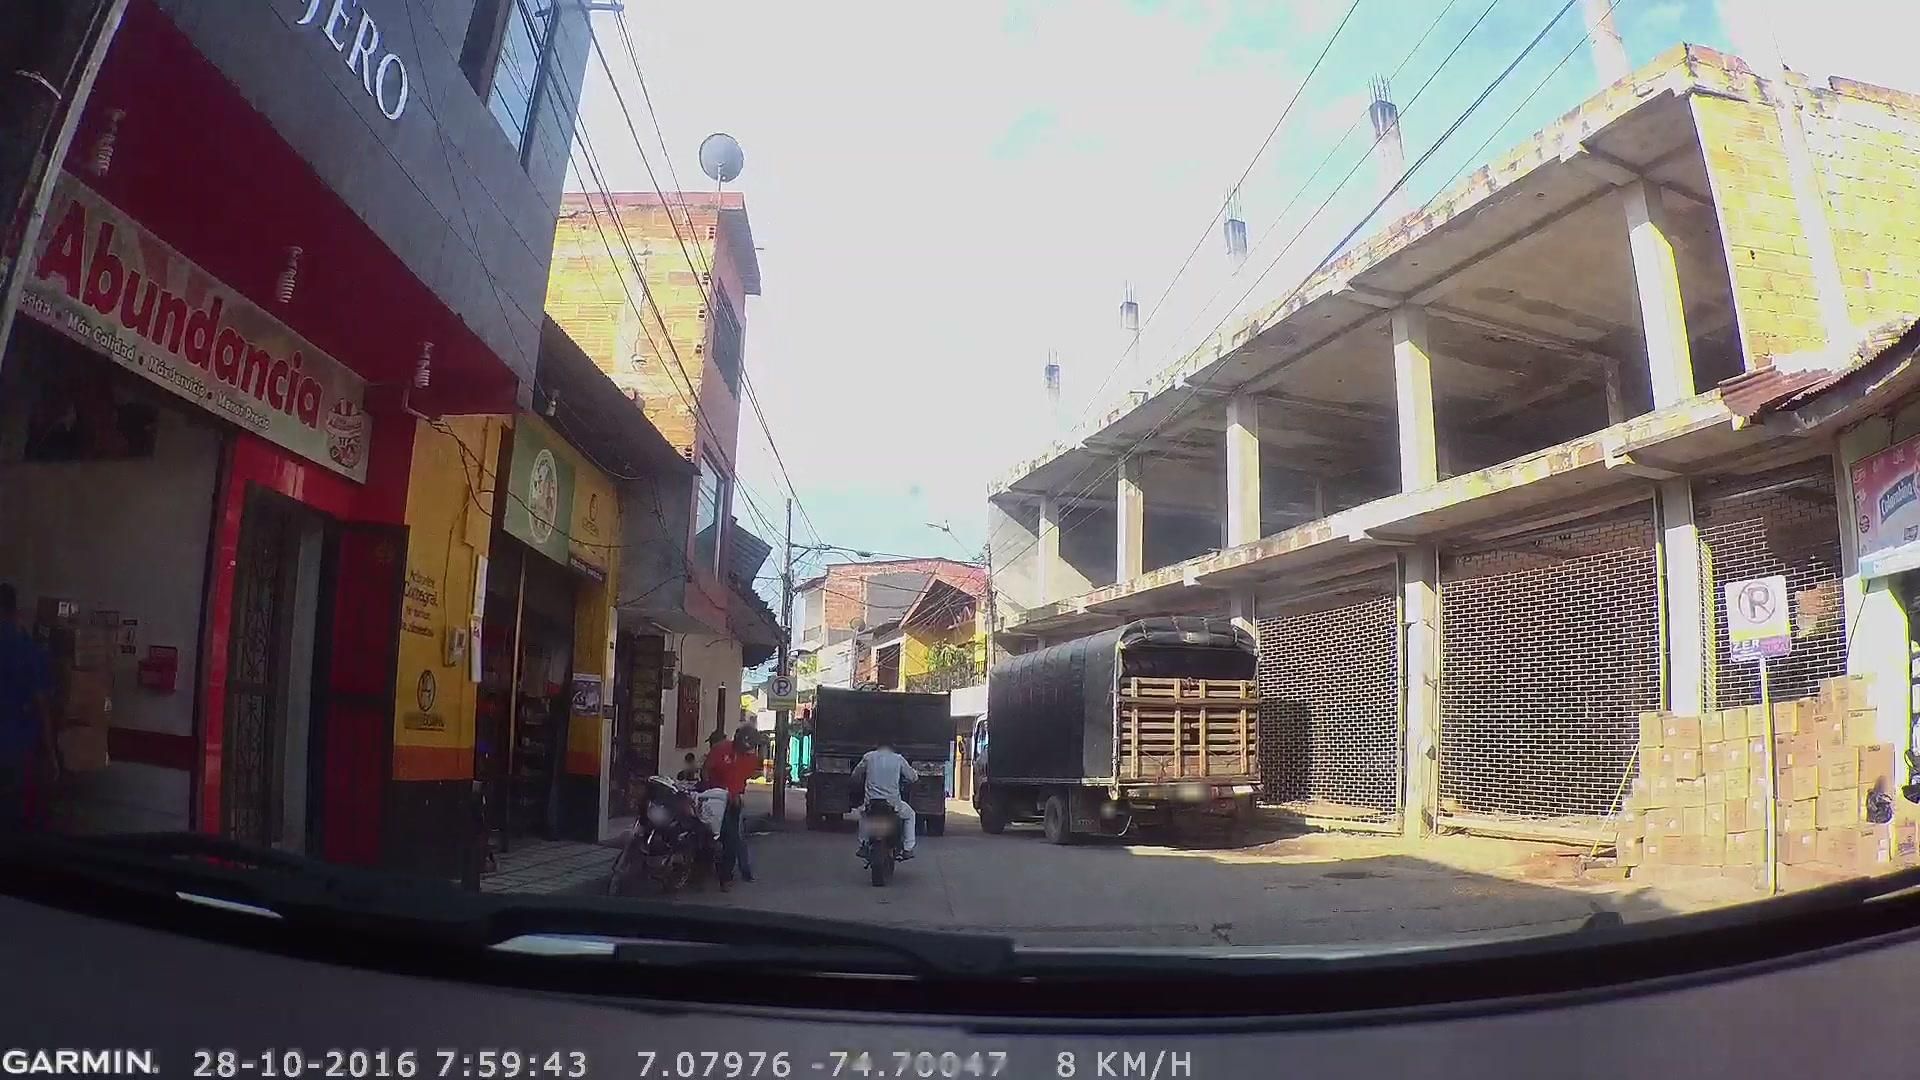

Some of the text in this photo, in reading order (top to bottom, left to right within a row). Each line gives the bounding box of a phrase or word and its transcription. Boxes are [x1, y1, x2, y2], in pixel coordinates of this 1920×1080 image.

[34, 200, 323, 430] Abundancia
[68, 313, 91, 338] Máx
[93, 328, 136, 361] Calidad
